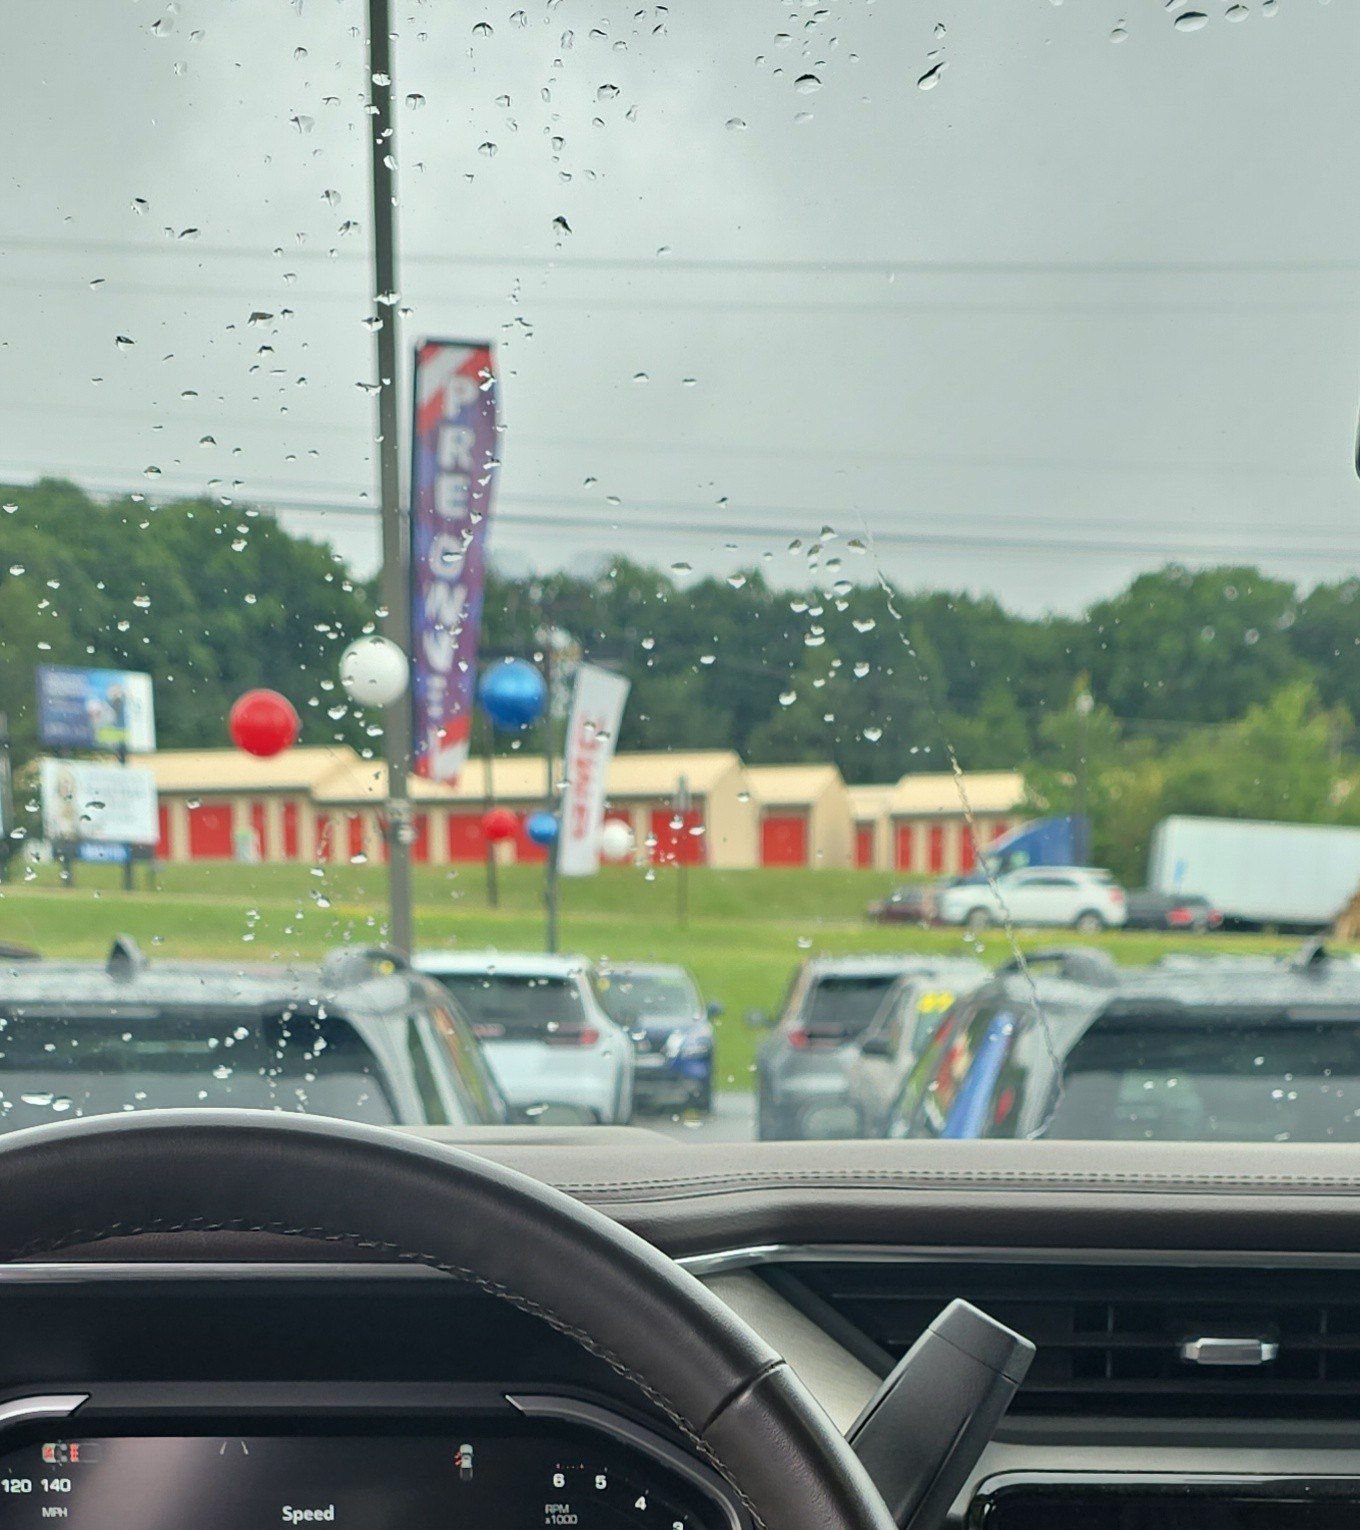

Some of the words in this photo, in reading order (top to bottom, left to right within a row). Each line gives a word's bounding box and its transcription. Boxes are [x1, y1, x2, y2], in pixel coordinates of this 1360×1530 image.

[1, 1478, 33, 1493] 120
[41, 1478, 72, 1493] 140
[552, 1472, 566, 1488] 6
[594, 1474, 608, 1490] 5
[544, 1503, 571, 1514] RPM
[634, 1495, 648, 1511] 4
[42, 1506, 68, 1518] MPH
[282, 1504, 335, 1525] Speed
